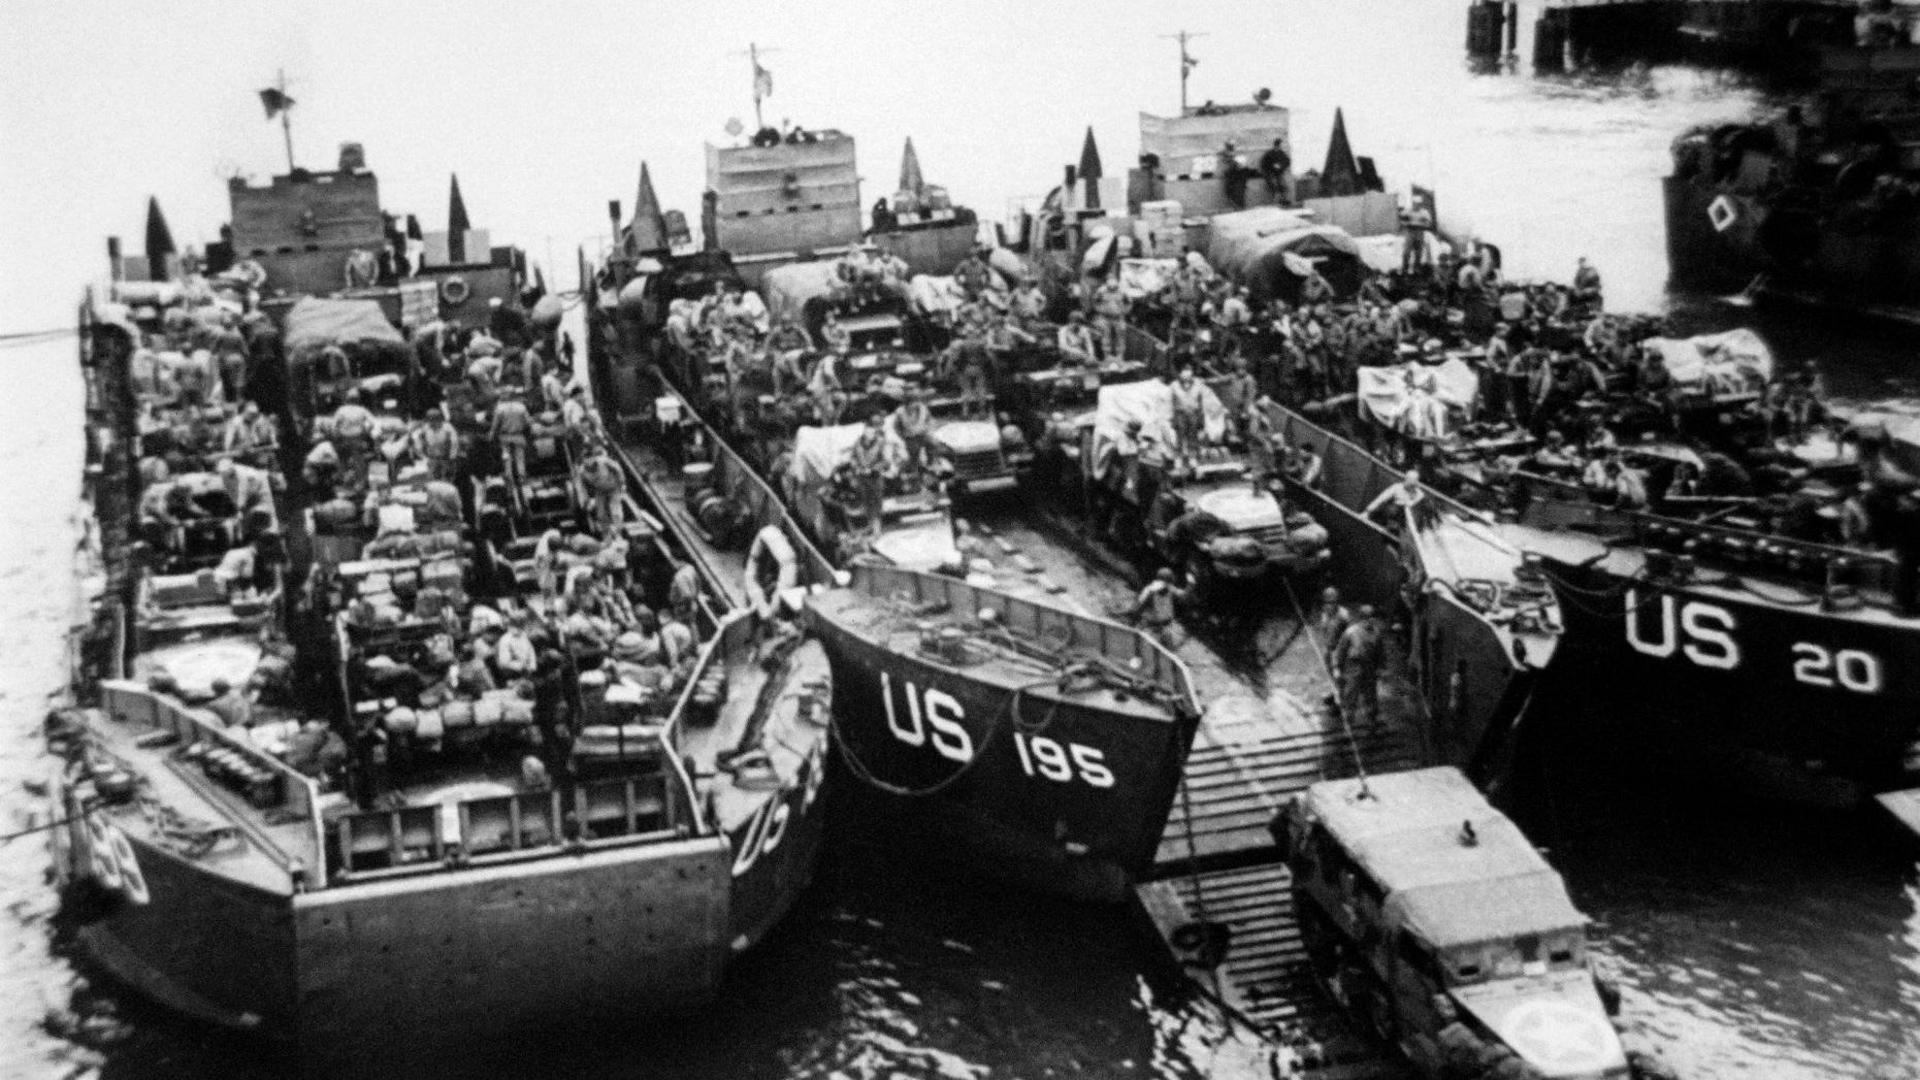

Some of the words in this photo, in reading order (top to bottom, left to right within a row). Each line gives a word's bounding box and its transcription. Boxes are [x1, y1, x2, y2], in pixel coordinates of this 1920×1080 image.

[1625, 588, 1740, 670] US
[1791, 642, 1881, 693] 20
[880, 671, 974, 763] US
[1014, 732, 1116, 788] 195
